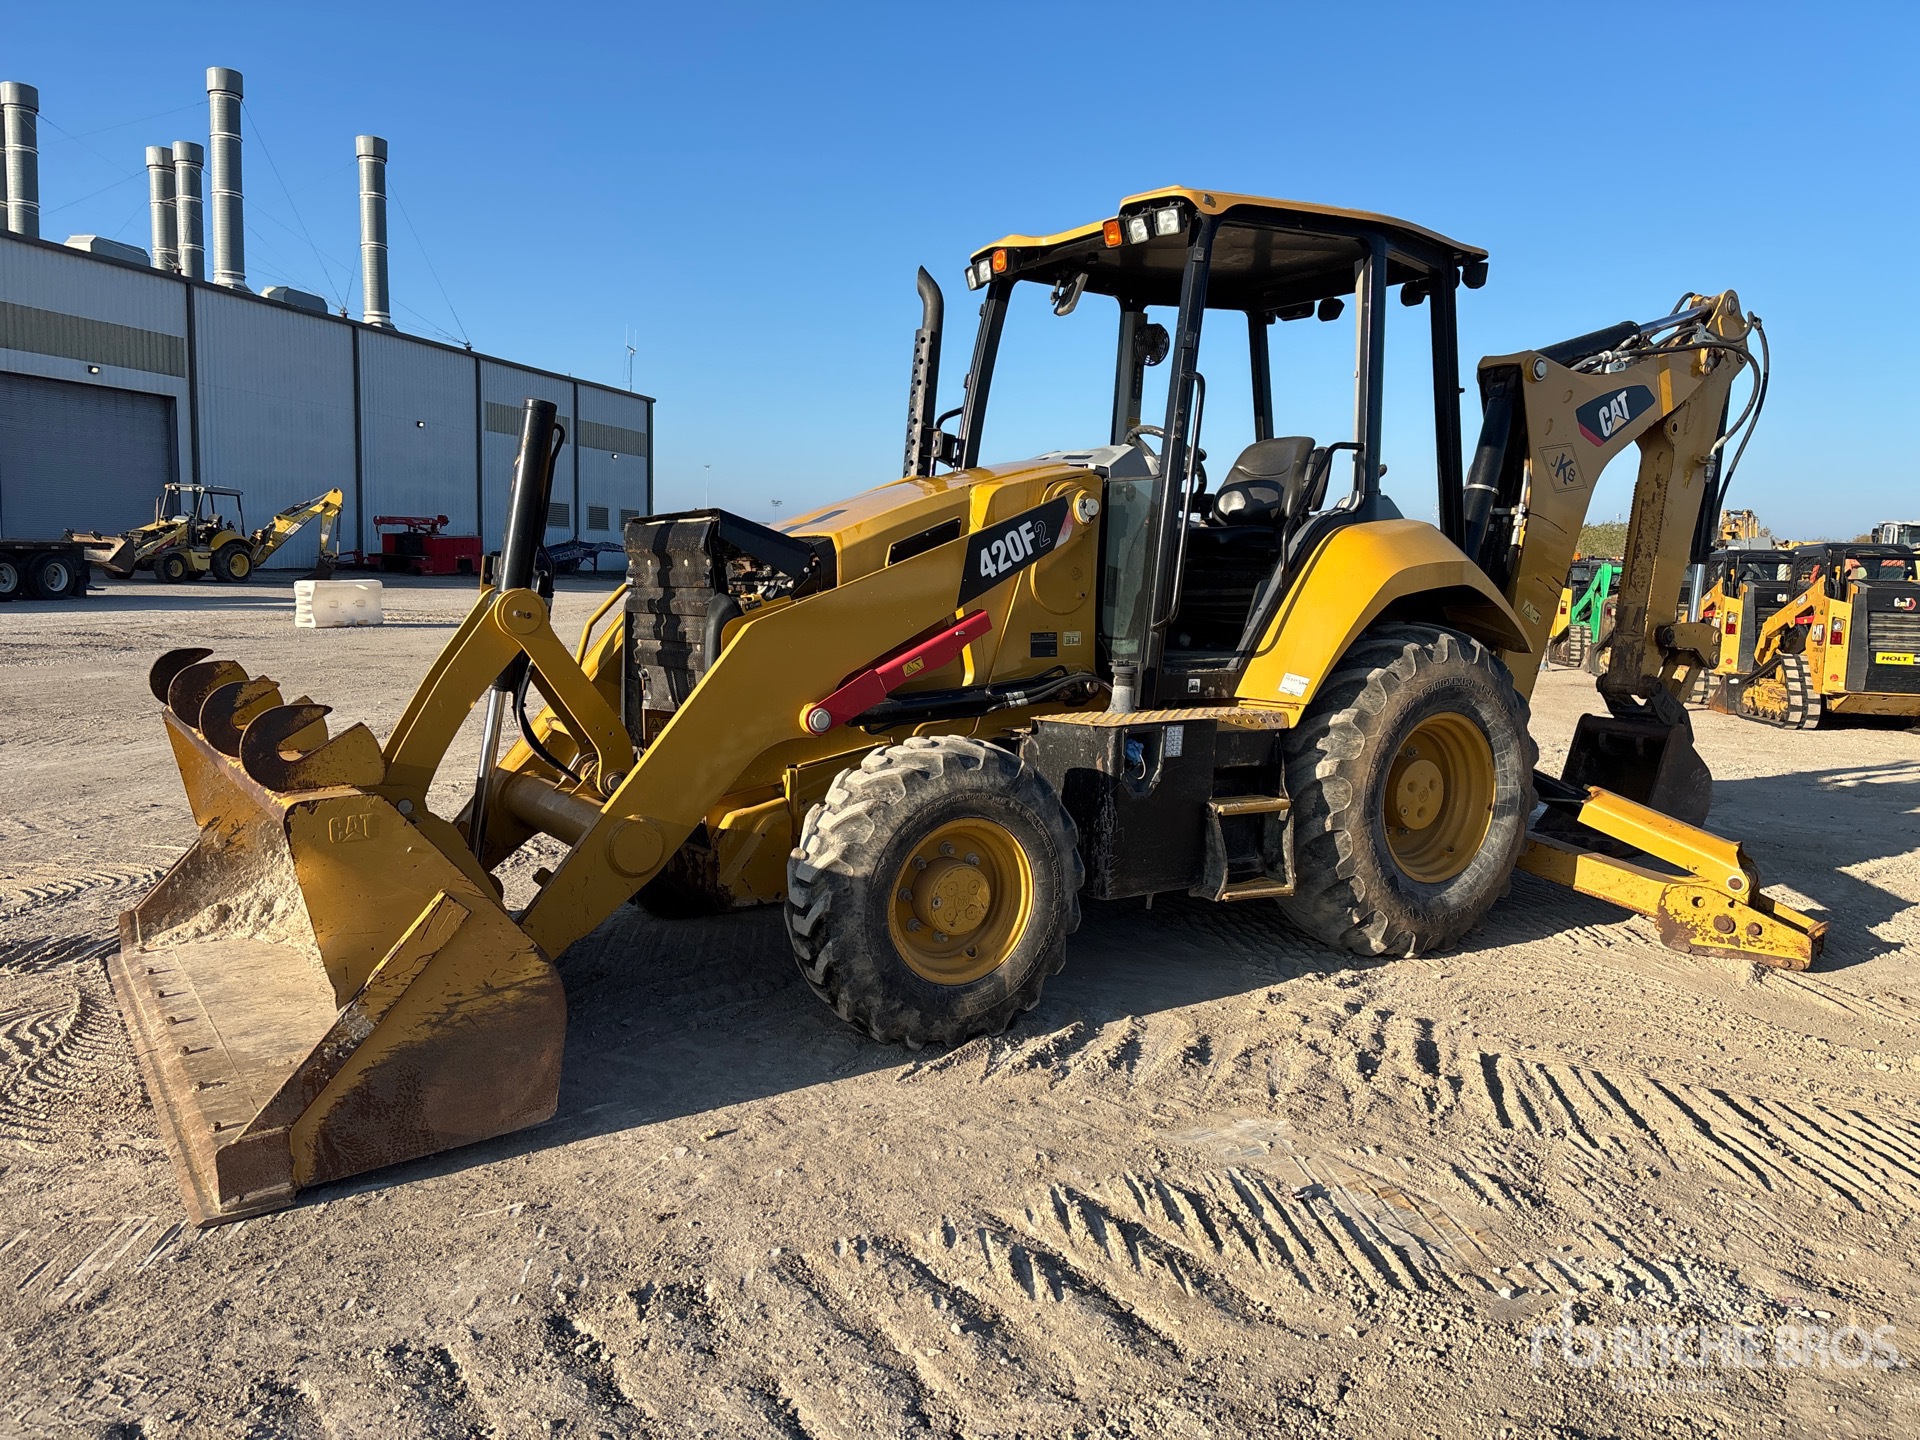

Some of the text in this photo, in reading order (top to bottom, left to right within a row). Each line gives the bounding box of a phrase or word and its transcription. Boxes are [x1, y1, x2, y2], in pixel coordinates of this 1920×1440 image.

[1598, 390, 1630, 437] CAT
[1420, 677, 1474, 698] RIDER
[328, 812, 374, 844] CAT
